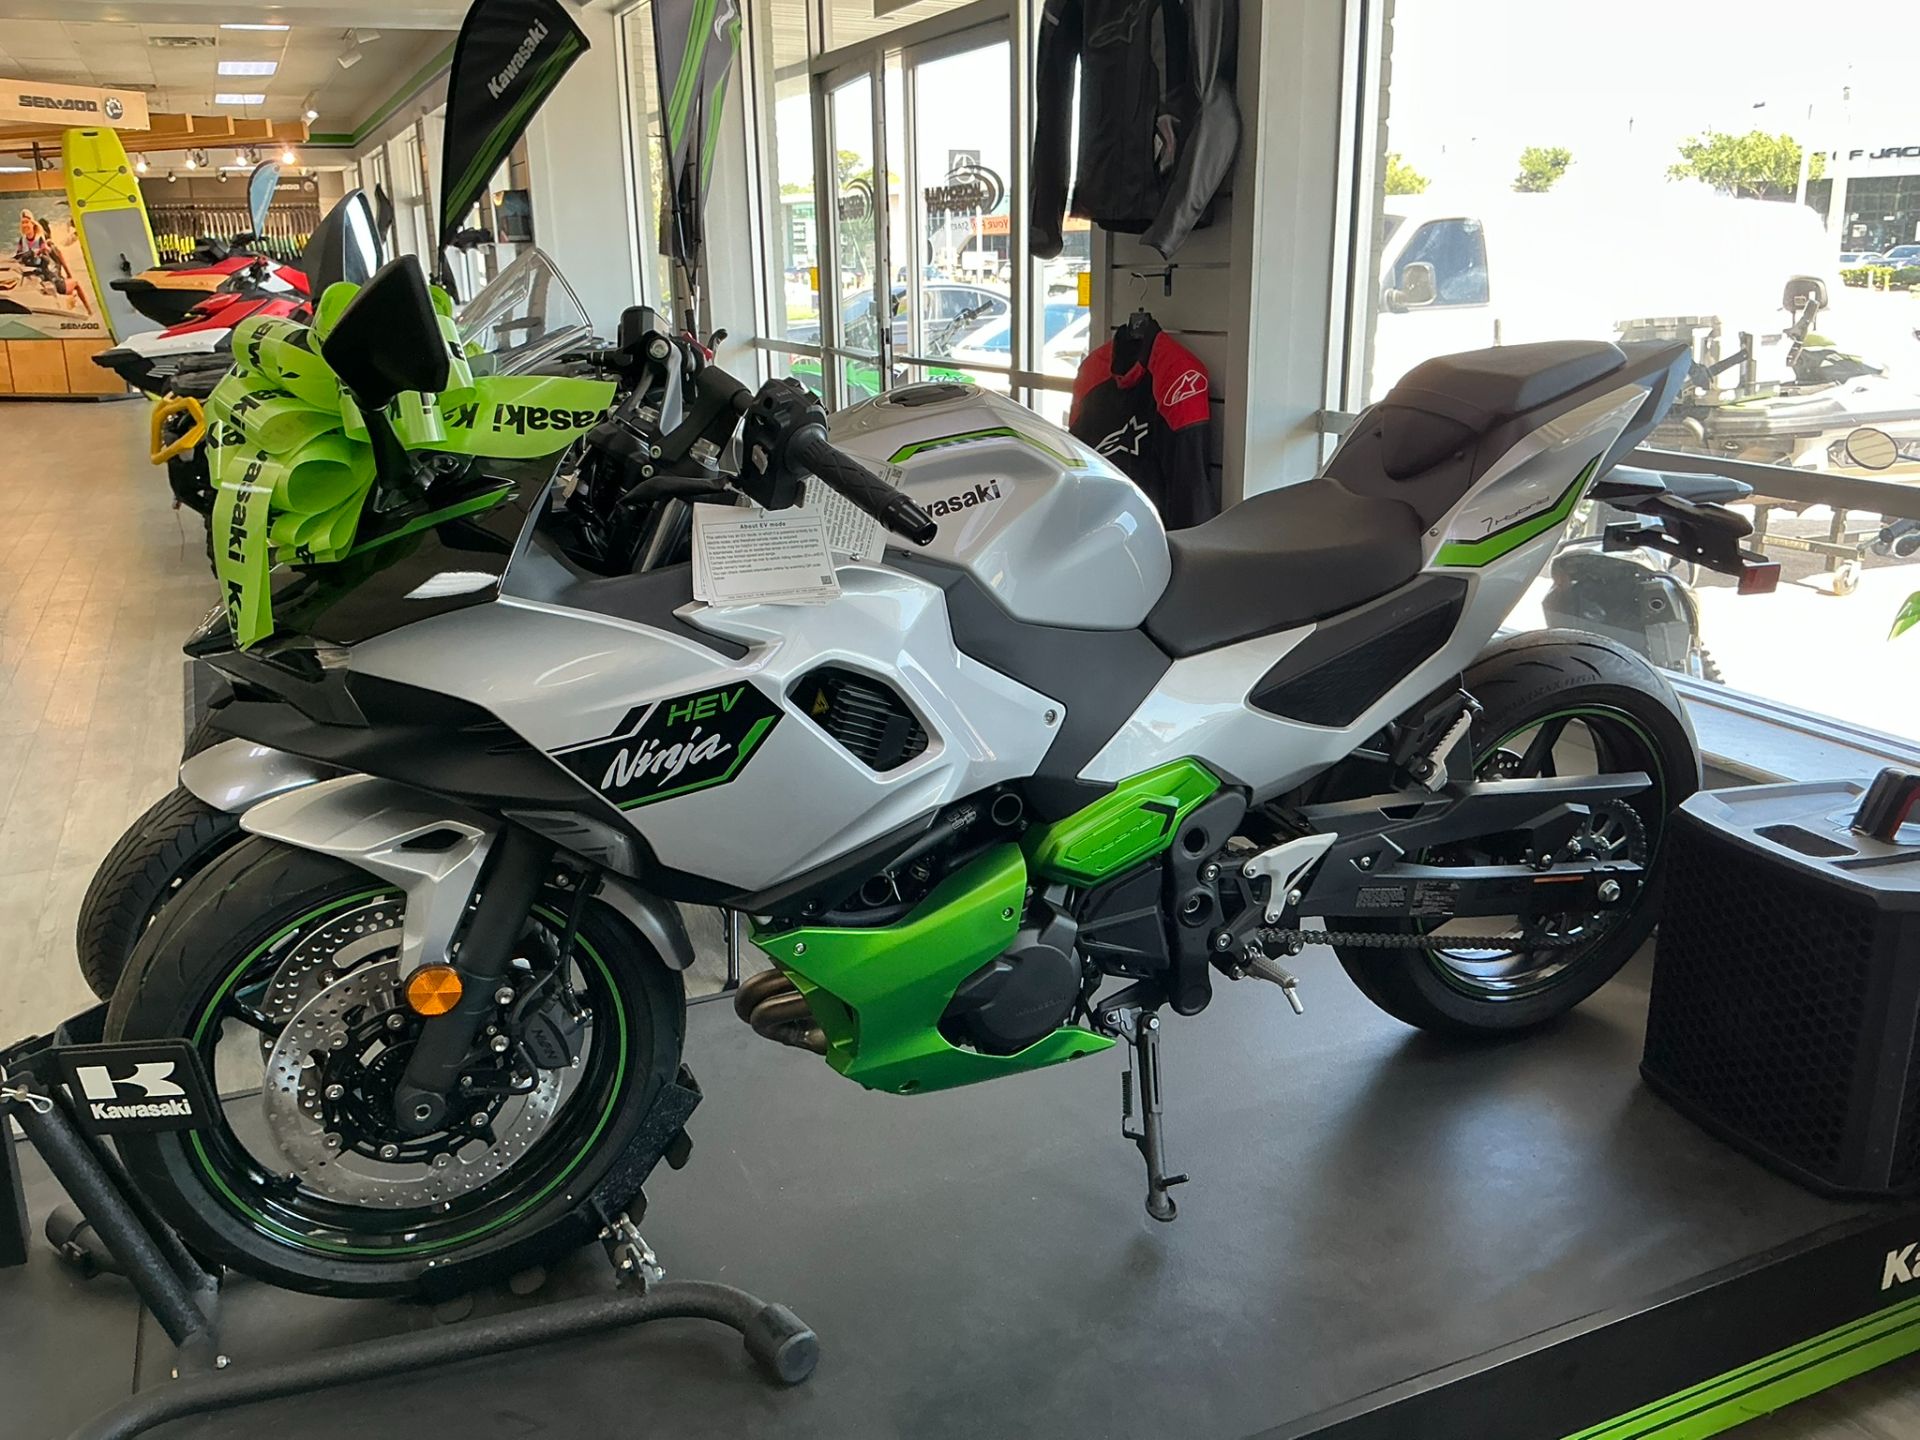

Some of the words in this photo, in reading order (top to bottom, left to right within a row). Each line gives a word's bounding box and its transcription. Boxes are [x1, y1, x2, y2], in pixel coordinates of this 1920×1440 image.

[487, 18, 549, 99] Kawasaki
[667, 686, 746, 727] HEV
[600, 726, 732, 790] Ninja
[89, 1098, 193, 1120] Kawasaki
